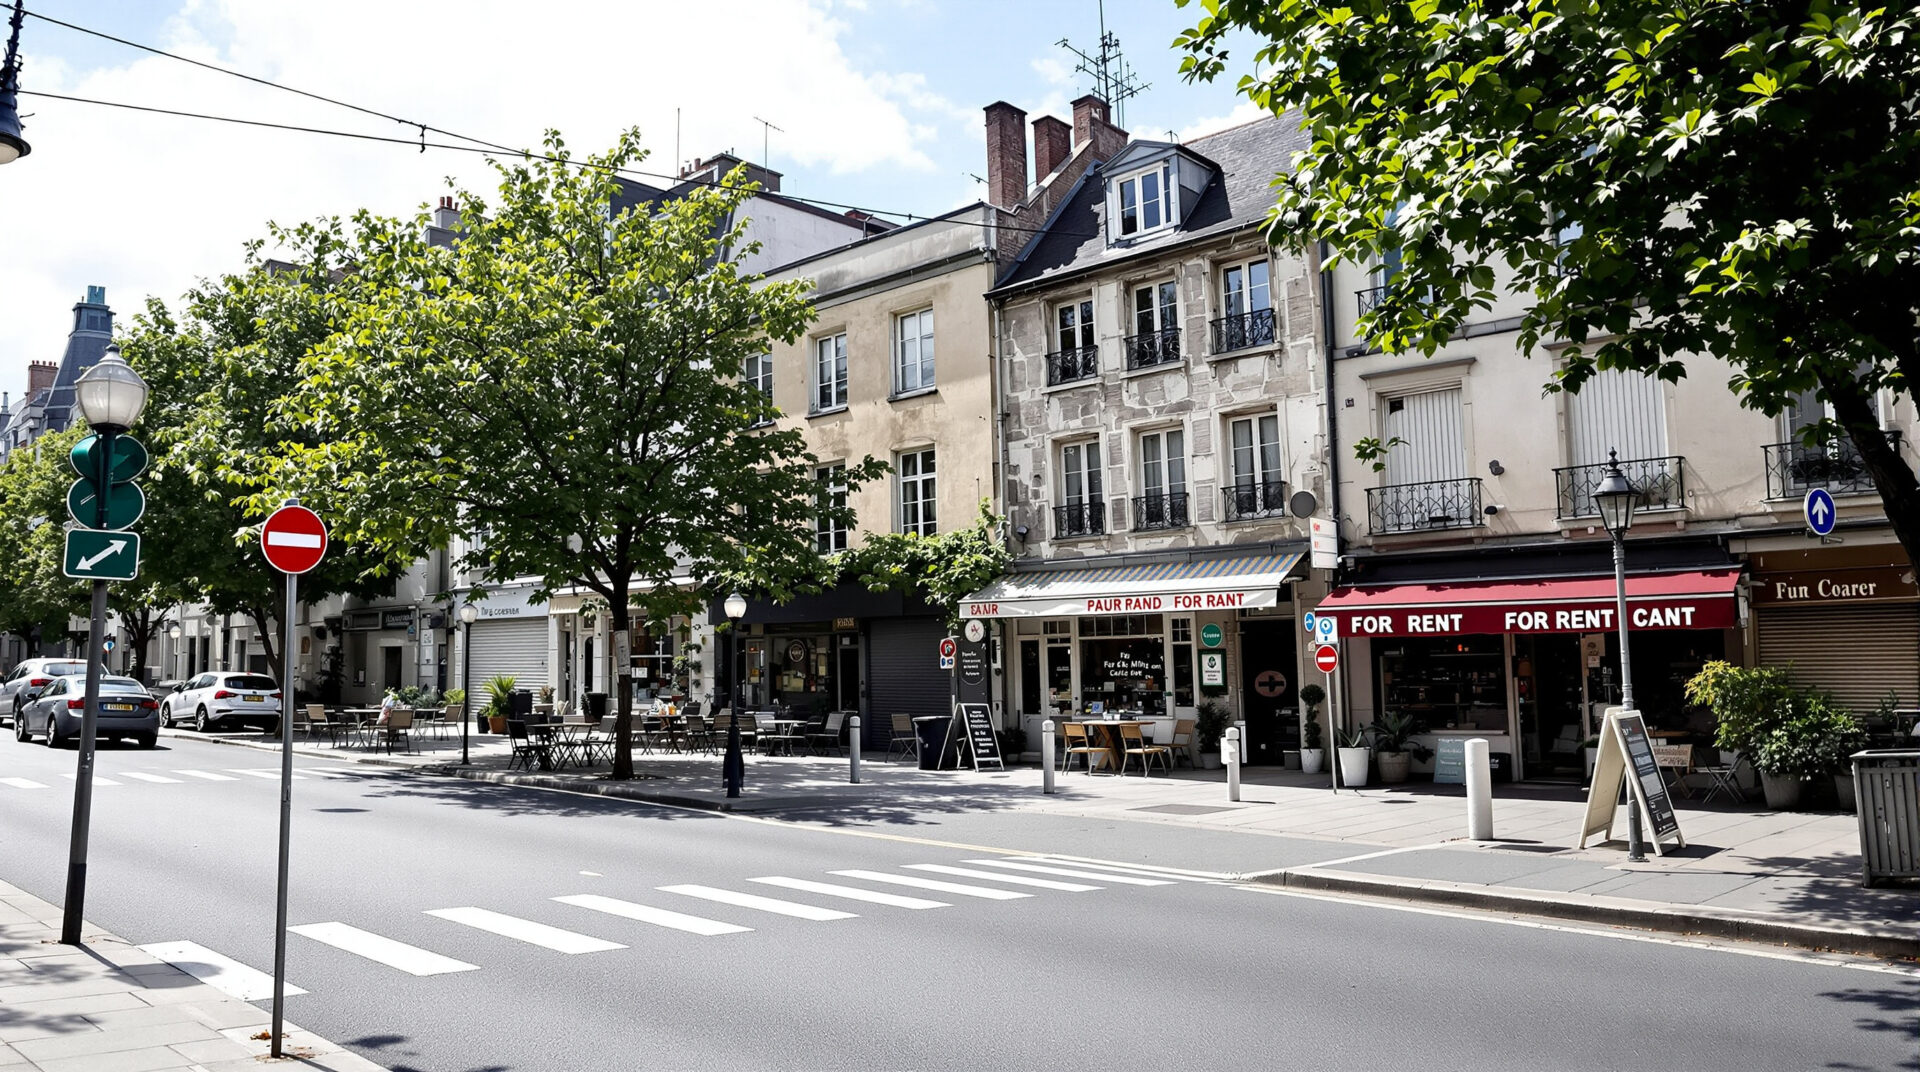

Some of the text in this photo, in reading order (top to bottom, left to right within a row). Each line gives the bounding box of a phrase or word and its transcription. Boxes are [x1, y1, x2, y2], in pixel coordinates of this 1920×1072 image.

[1775, 578, 1877, 599] Fun Coarer
[1087, 593, 1245, 612] PAUR RAND FOR RANT
[1351, 613, 1463, 634] FOR RENT
[1504, 606, 1696, 630] FOR RENT CANT
